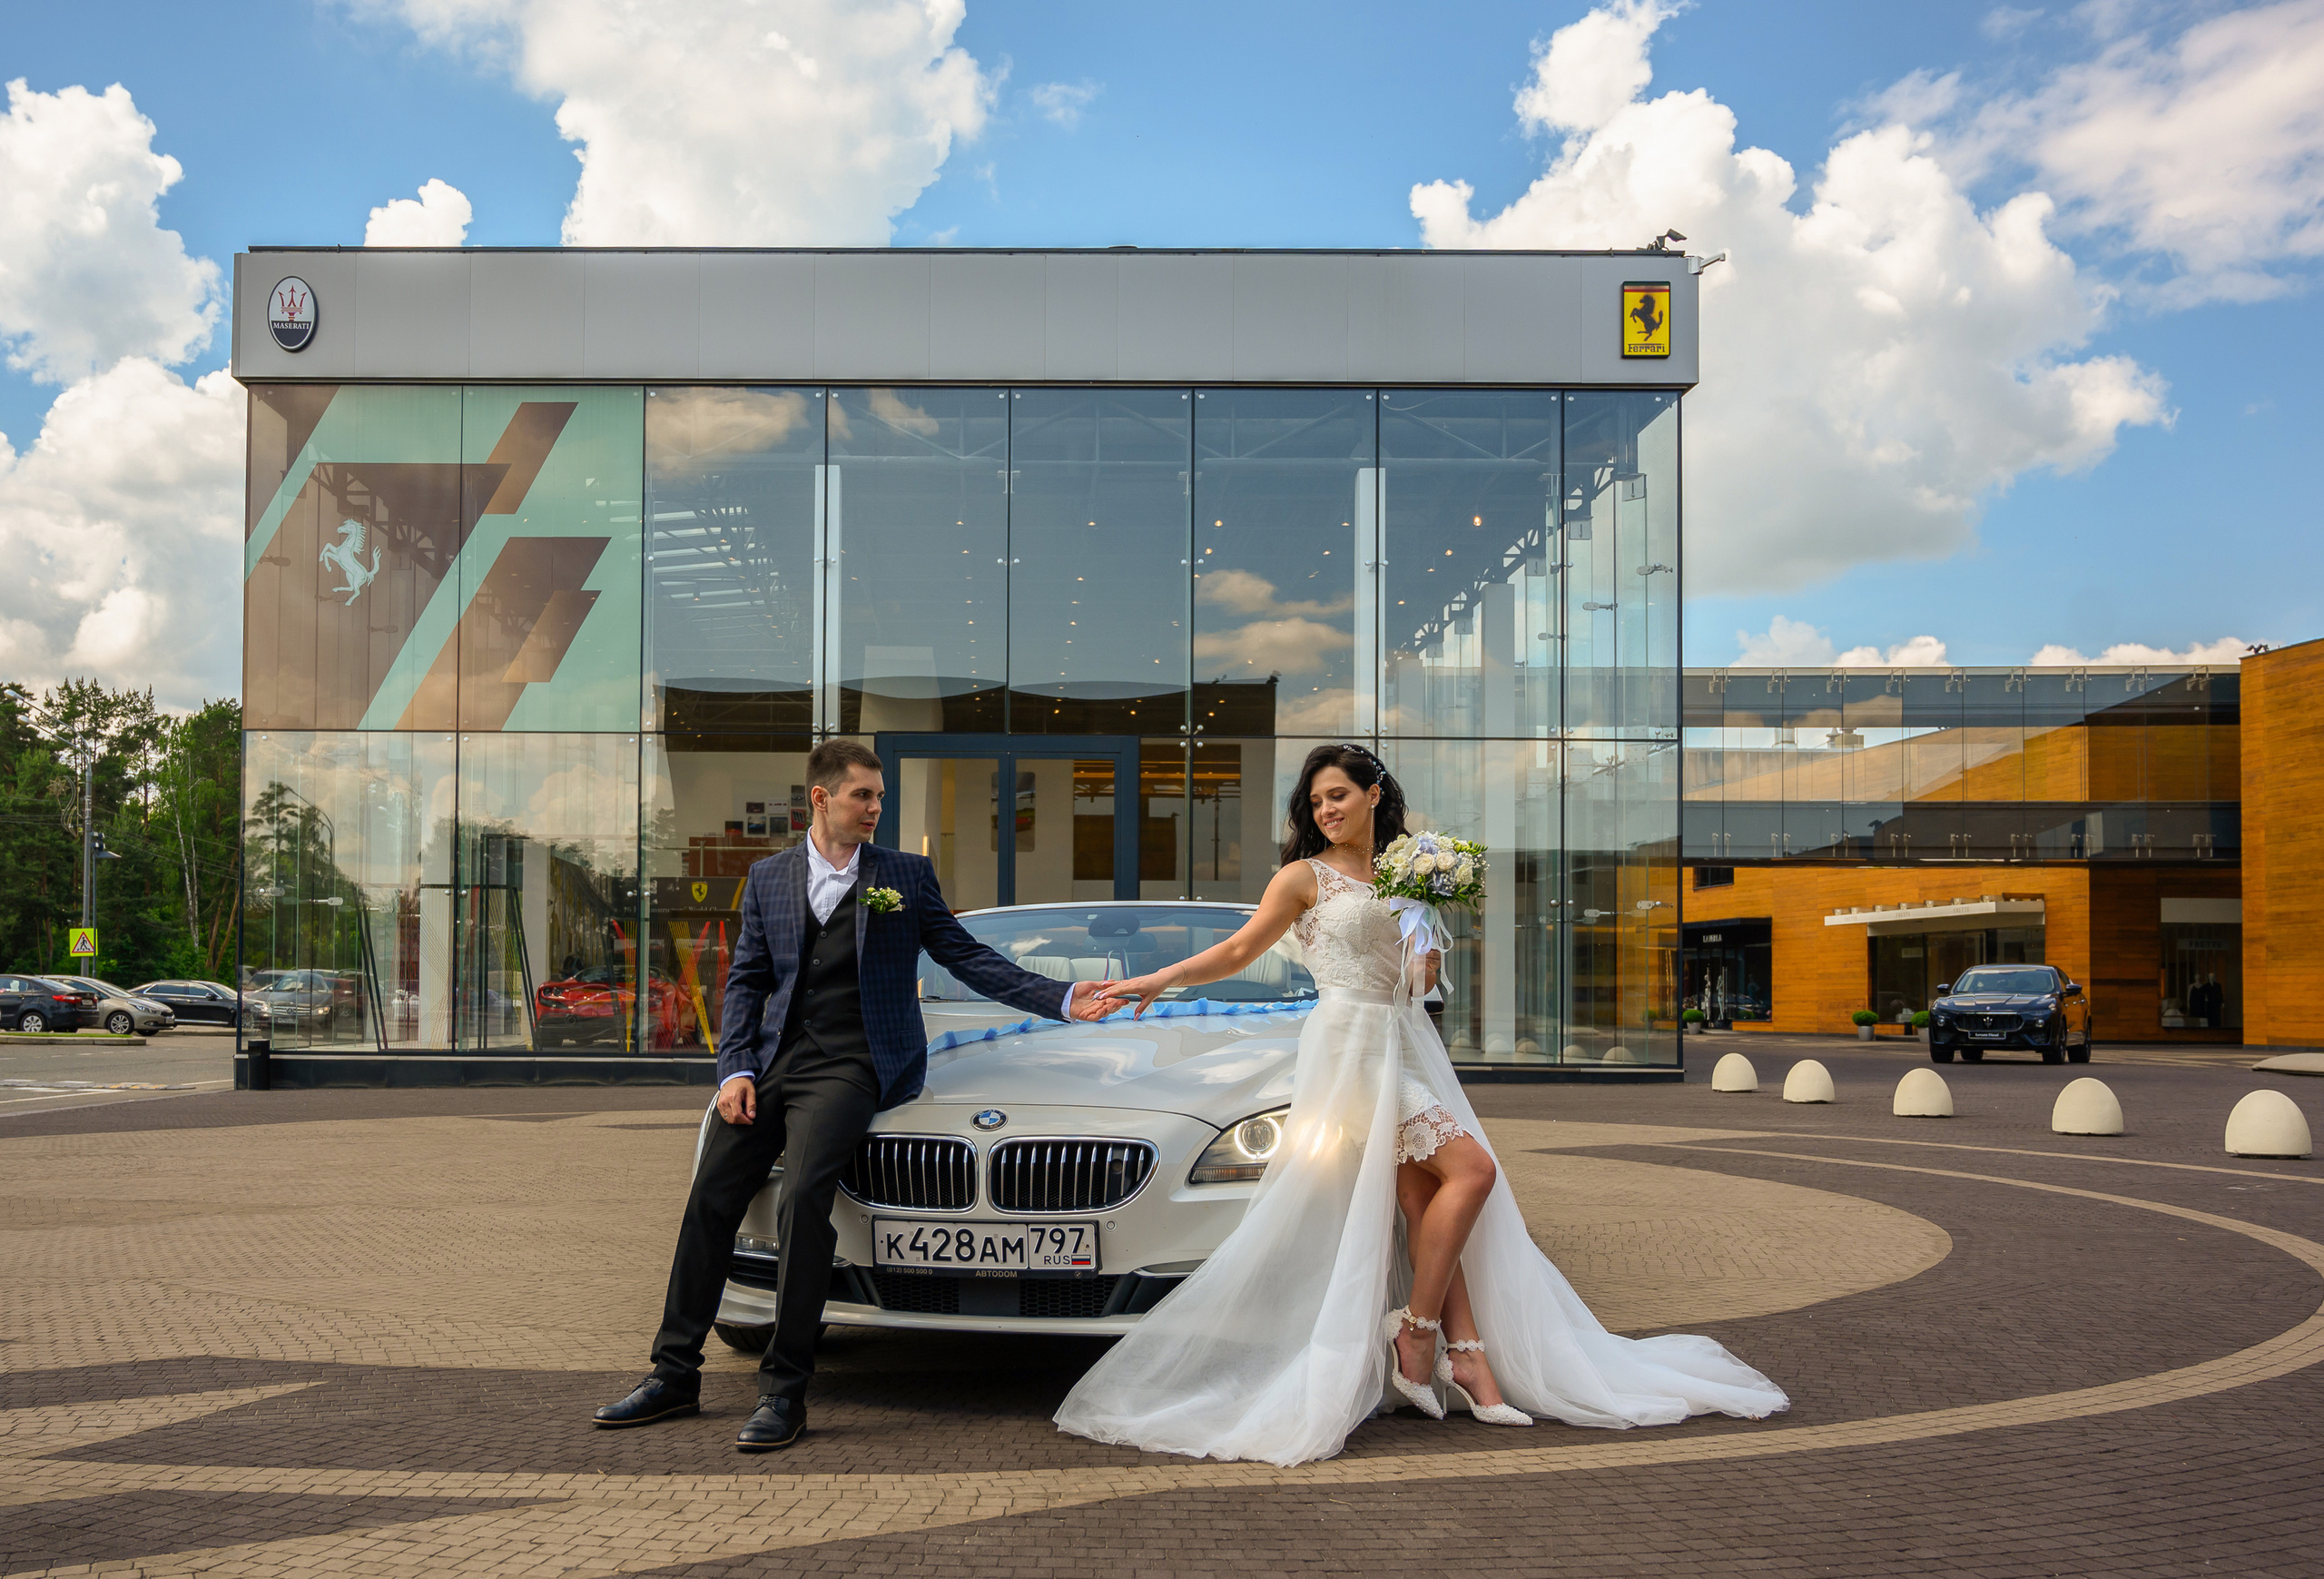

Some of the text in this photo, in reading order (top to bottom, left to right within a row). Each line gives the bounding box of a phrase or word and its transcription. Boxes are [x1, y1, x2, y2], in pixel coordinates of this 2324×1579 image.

[1628, 343, 1665, 352] Ferrari
[886, 1227, 1084, 1263] K428AM 797
[1044, 1255, 1070, 1265] RUS
